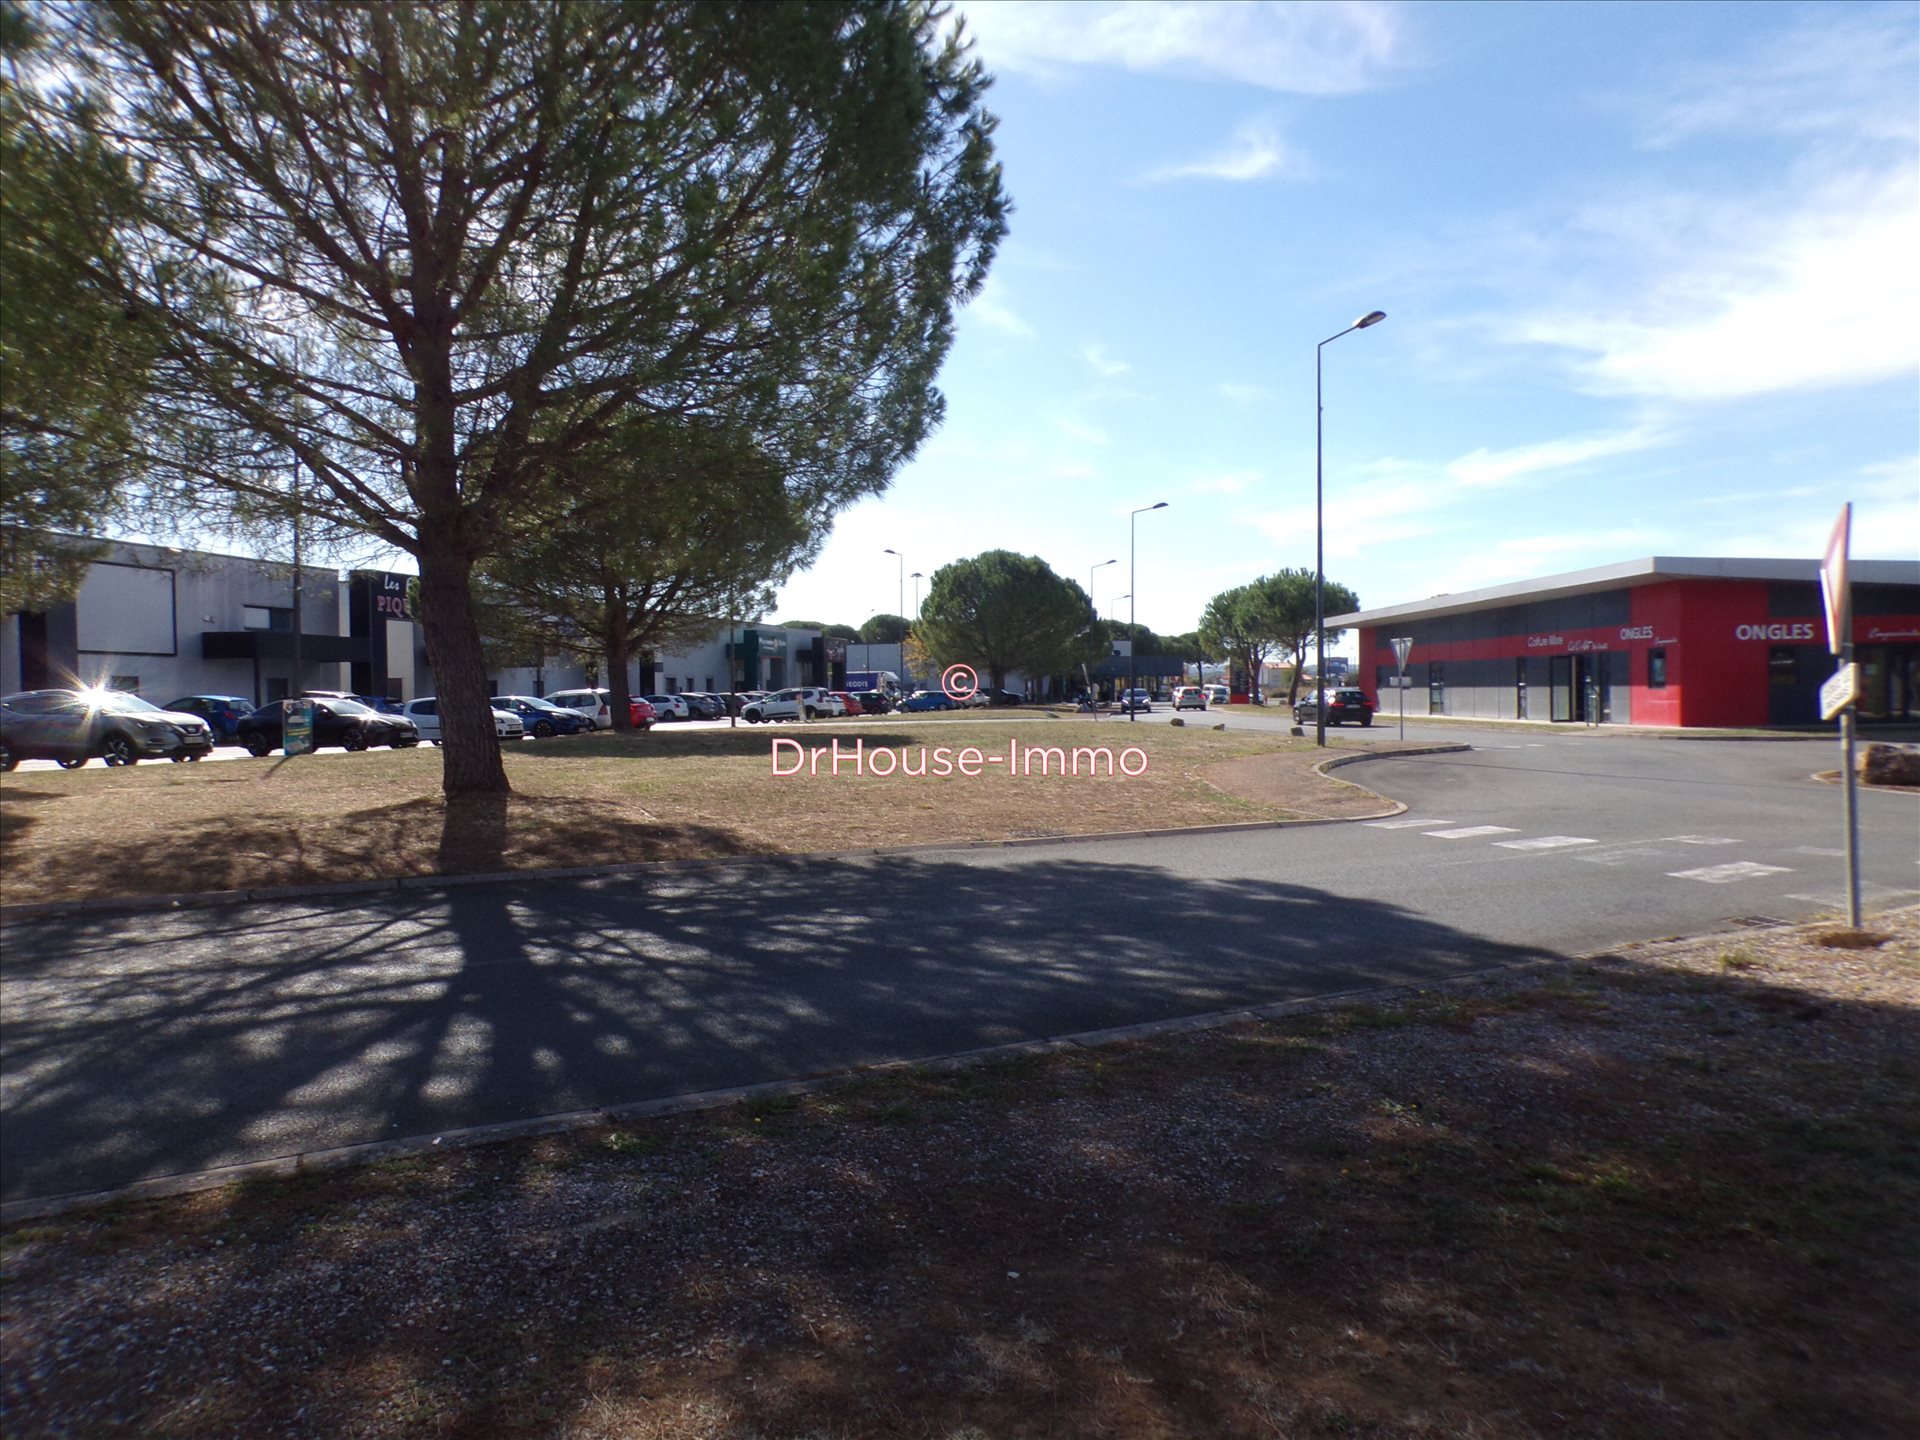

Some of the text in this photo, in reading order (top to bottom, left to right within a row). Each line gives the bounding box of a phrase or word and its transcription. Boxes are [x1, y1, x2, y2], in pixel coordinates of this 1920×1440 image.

[384, 574, 400, 591] Les
[1620, 626, 1654, 640] ONGLES
[1735, 623, 1815, 640] ONGLES
